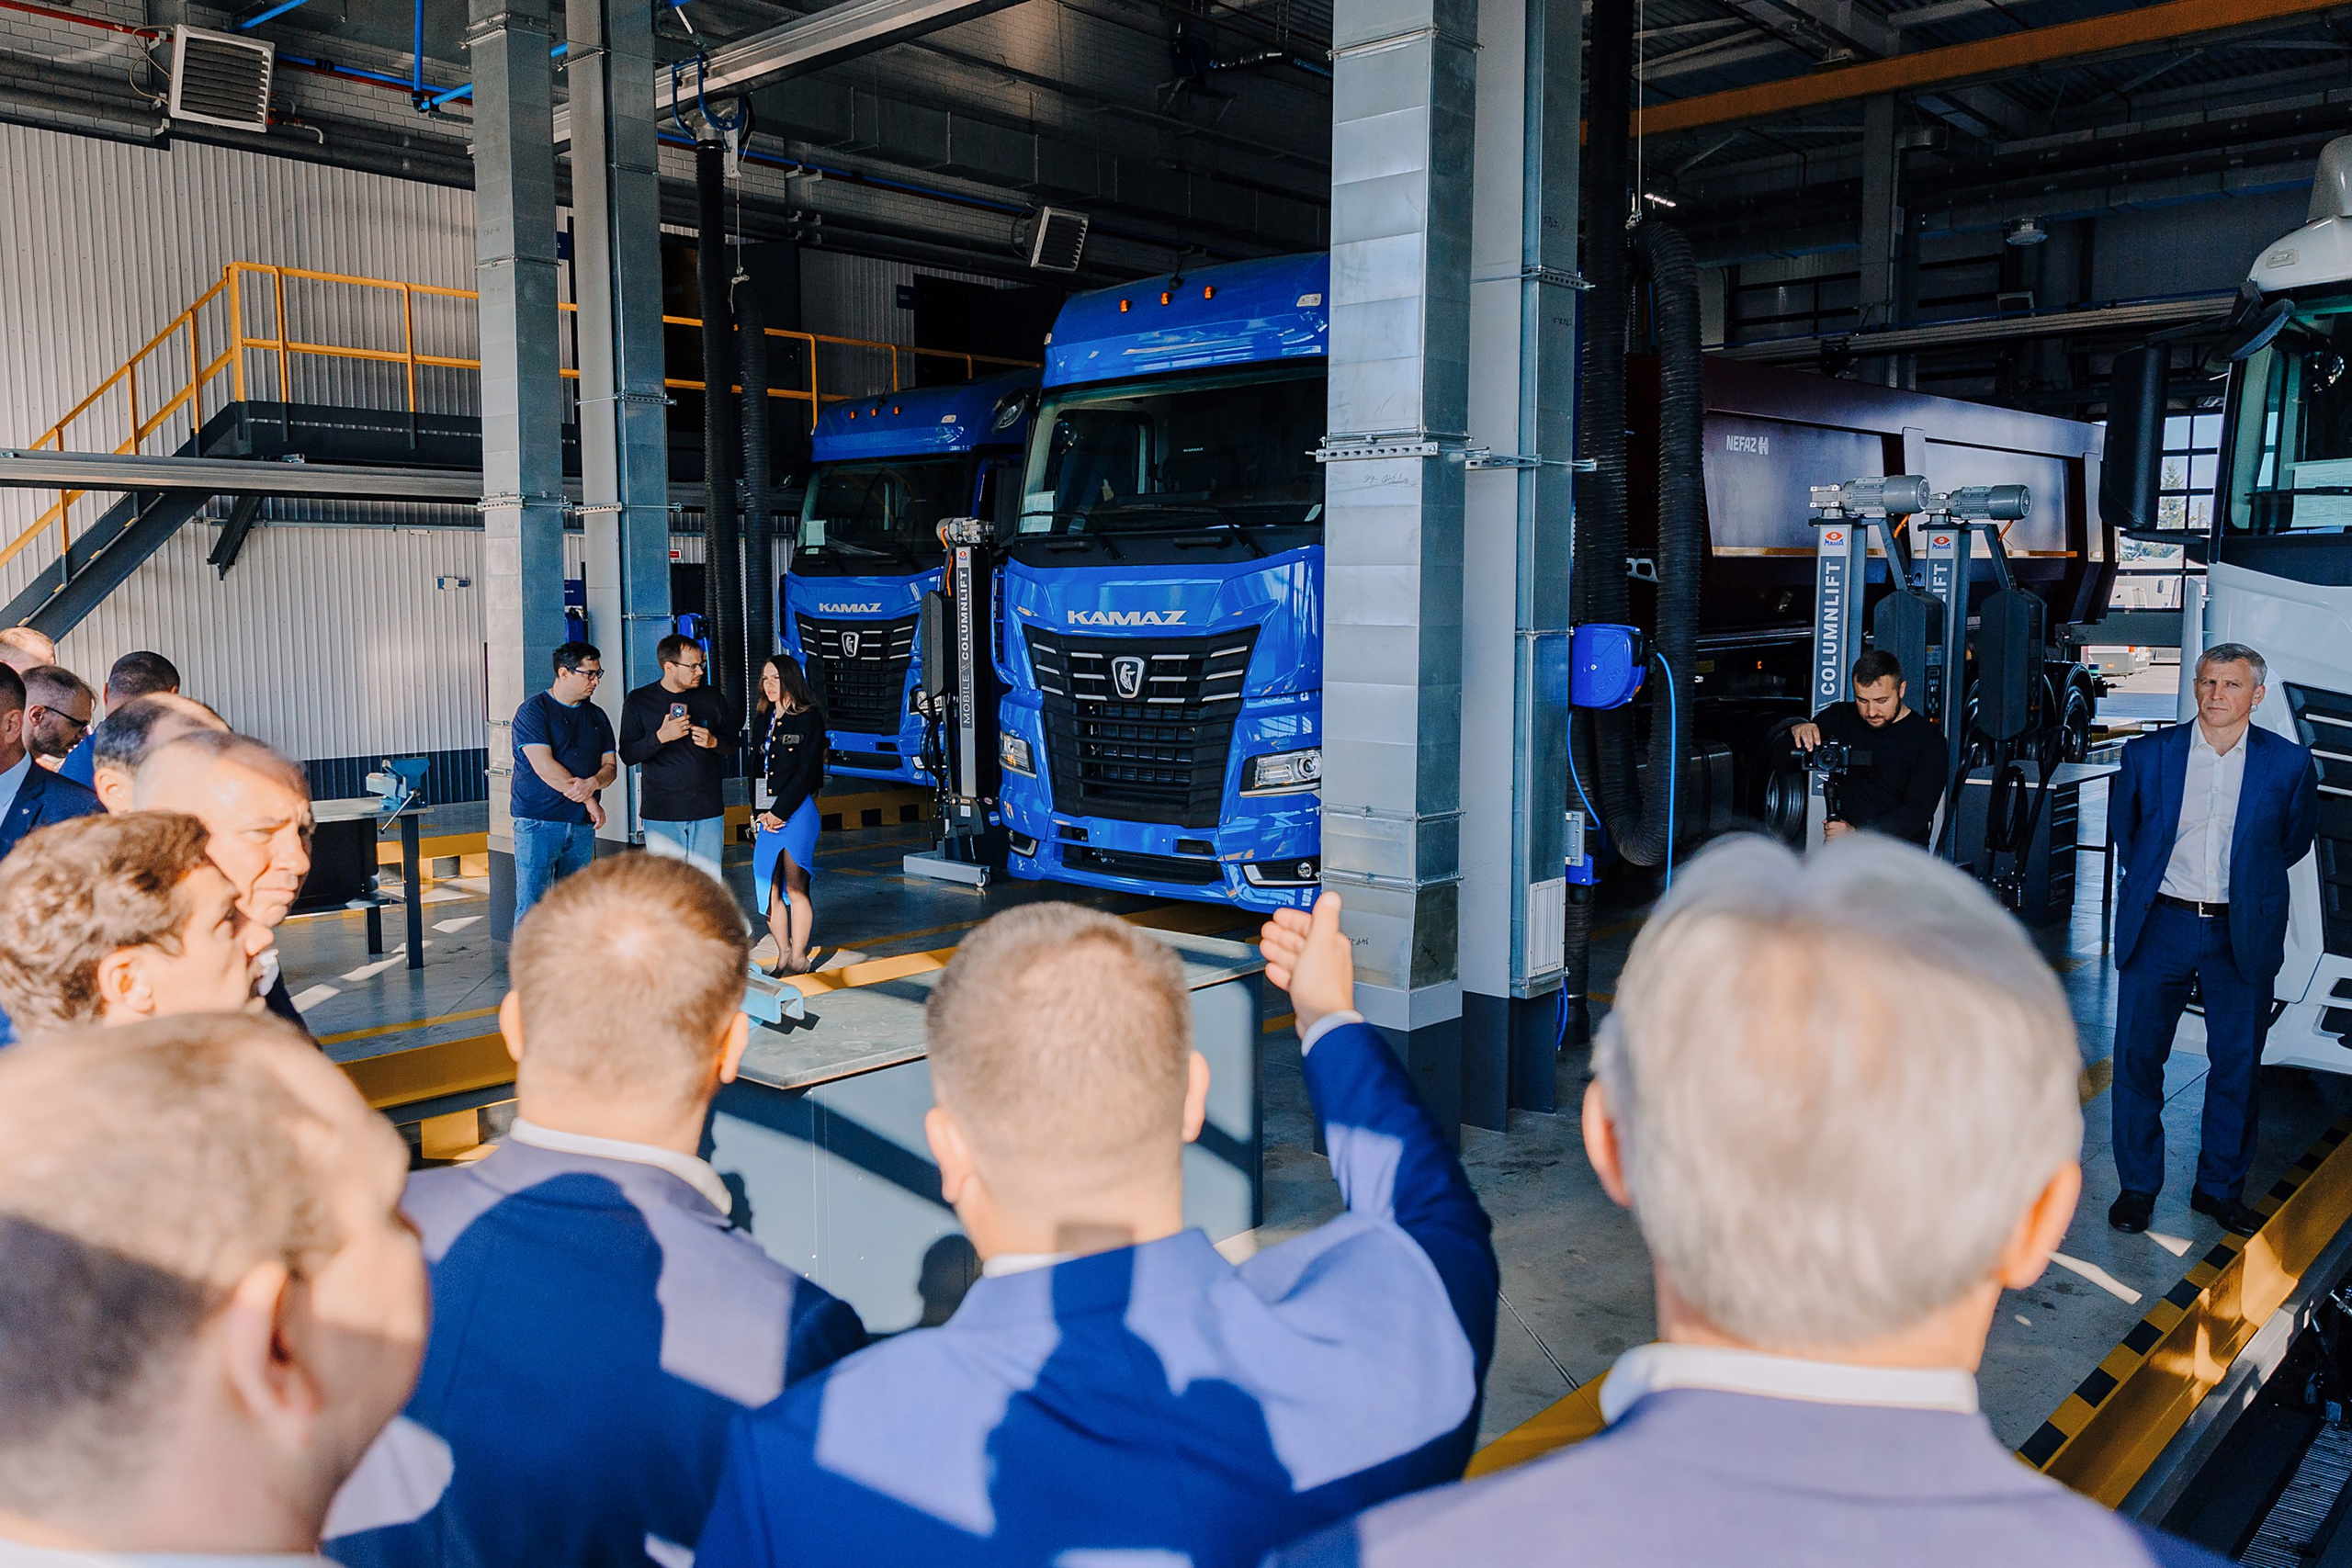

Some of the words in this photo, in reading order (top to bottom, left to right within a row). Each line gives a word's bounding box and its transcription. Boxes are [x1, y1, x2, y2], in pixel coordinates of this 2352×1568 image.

[1726, 435, 1757, 452] NEFAZ
[819, 603, 882, 613] KAMAZ
[960, 571, 969, 660] COLUMNLIFT
[1068, 610, 1186, 626] KAMAZ
[1821, 561, 1840, 695] COLUMNLIFT
[962, 674, 970, 724] MOBILE
